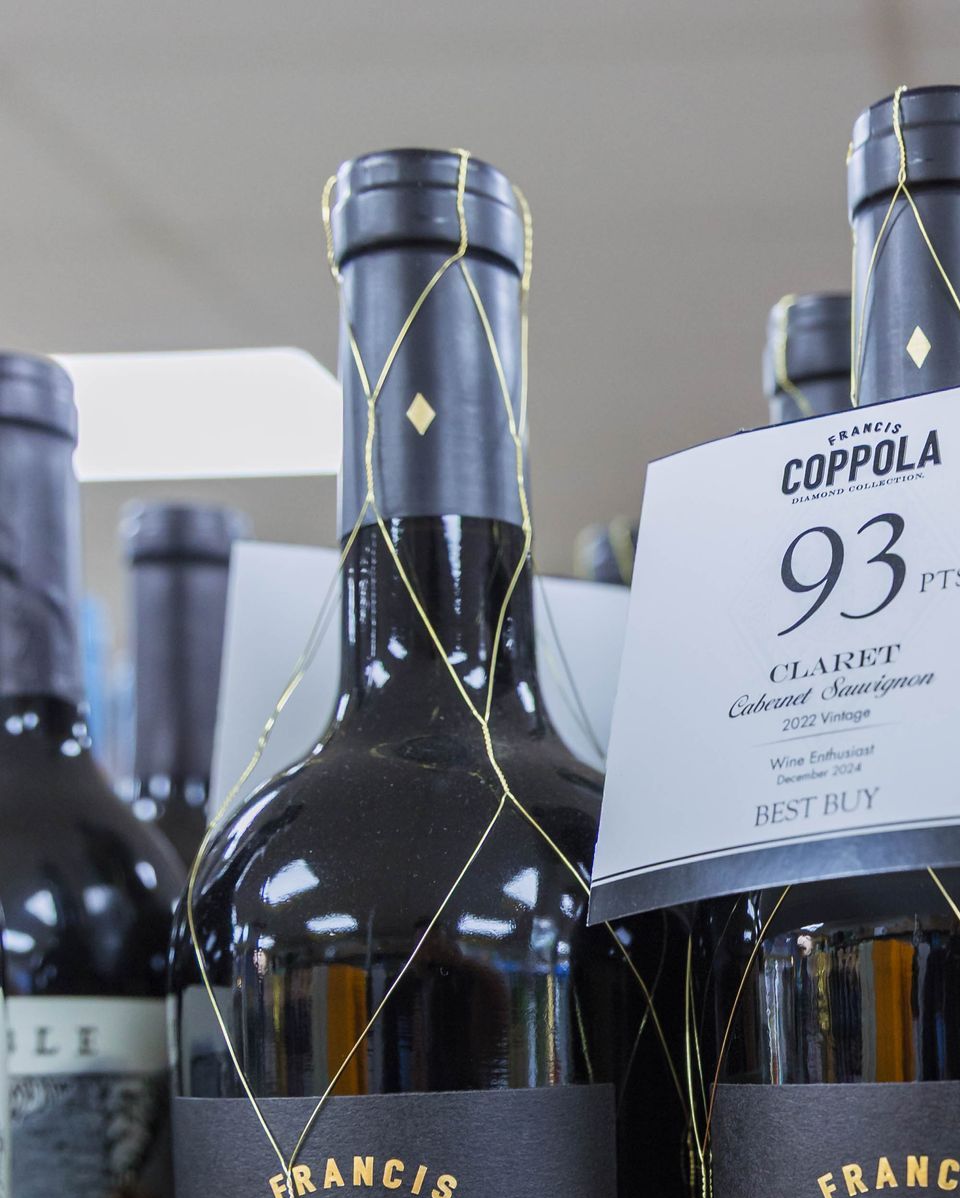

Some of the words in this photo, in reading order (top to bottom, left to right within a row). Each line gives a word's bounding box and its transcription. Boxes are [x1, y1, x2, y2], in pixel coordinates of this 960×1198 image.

[828, 422, 901, 446] FRANCIS
[782, 430, 942, 495] COPPOLA
[791, 488, 844, 504] DIAMOND
[777, 513, 906, 636] 93
[770, 644, 901, 683] CLARET
[728, 688, 812, 718] Cabernet
[821, 673, 935, 701] Sauvignon
[782, 714, 817, 731] 2022
[821, 708, 871, 724] Vintage
[770, 755, 804, 771] Wine
[810, 744, 875, 763] Enthusiast
[776, 769, 828, 785] December
[832, 763, 862, 777] 2024
[754, 796, 818, 827] BEST
[823, 787, 880, 815] BUY
